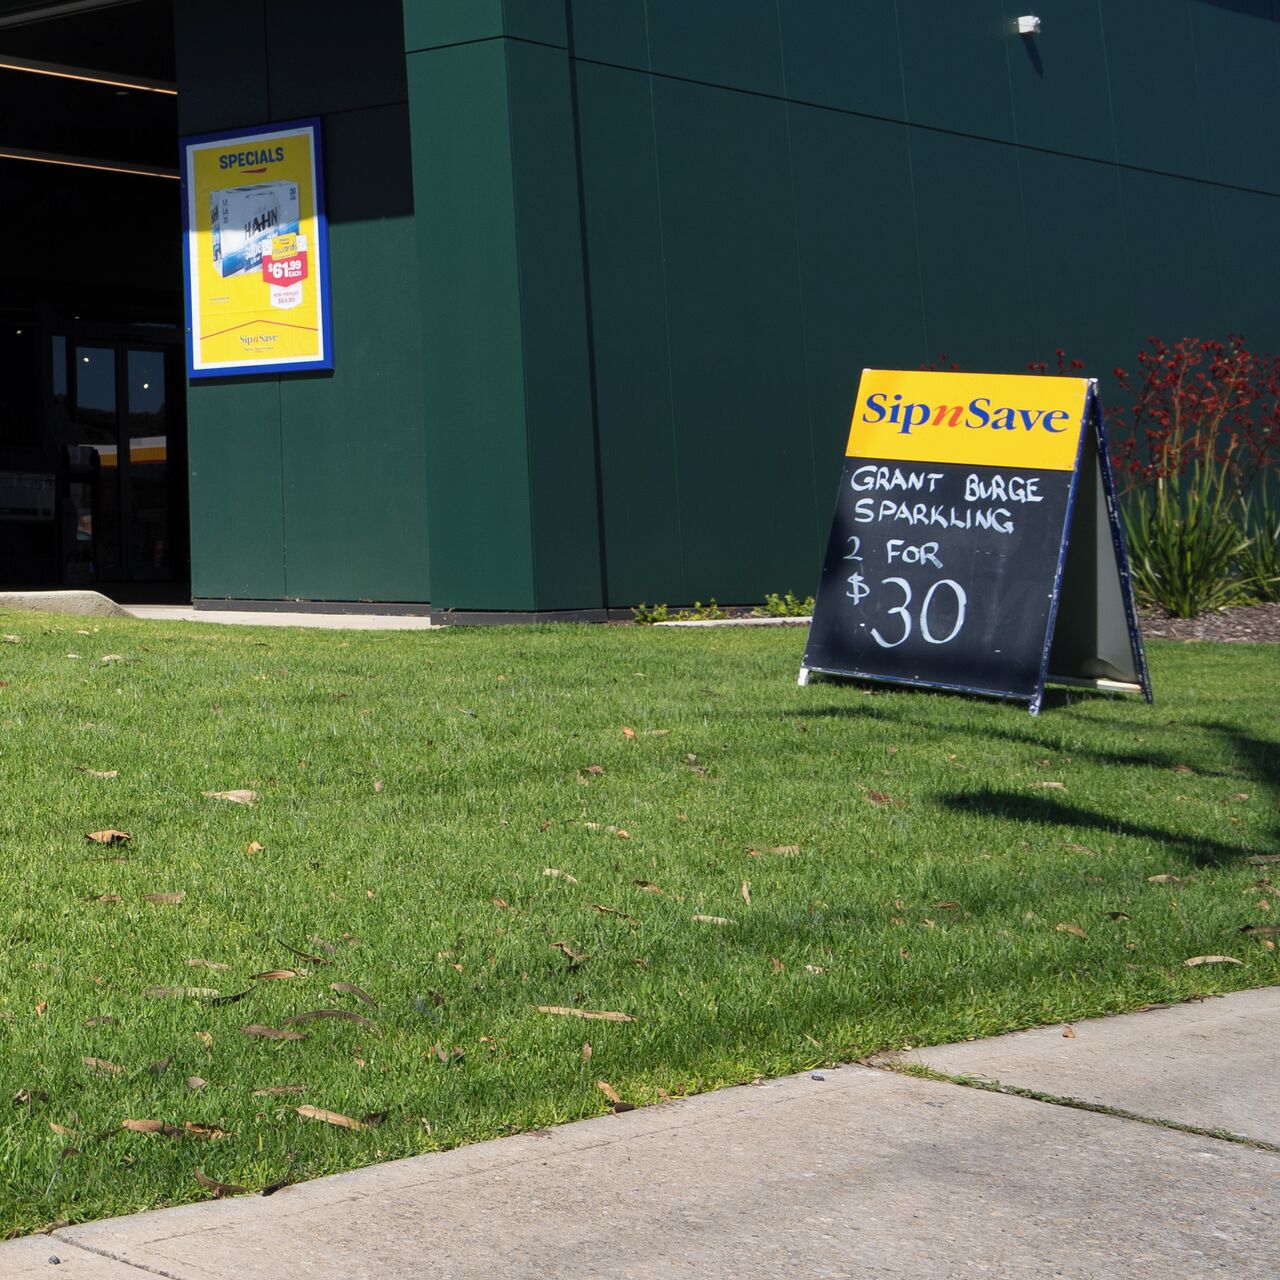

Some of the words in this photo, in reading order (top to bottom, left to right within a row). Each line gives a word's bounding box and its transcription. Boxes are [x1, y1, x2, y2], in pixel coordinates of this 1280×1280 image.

[219, 147, 285, 170] SPECIALS
[244, 207, 279, 240] HAHN
[268, 260, 302, 279] $61.99
[862, 393, 1070, 434] SipnSave
[850, 465, 944, 493] GRANT
[964, 474, 1044, 503] BURGE
[853, 498, 1015, 534] SPARKLING
[842, 535, 864, 562] 2
[886, 538, 944, 569] FOR
